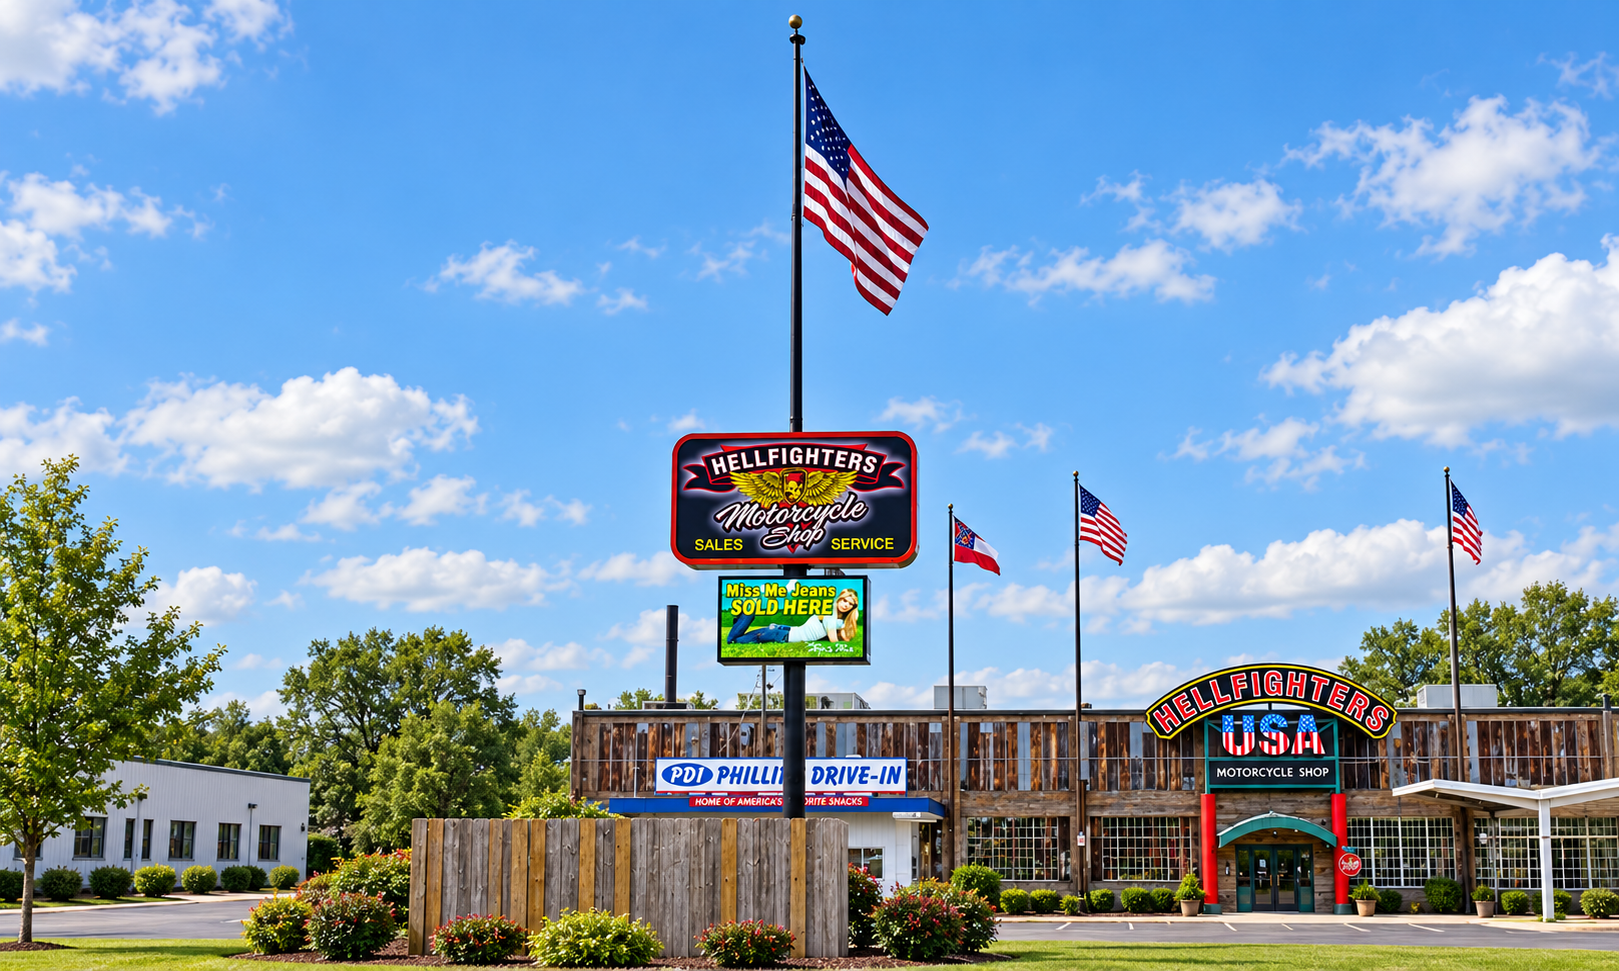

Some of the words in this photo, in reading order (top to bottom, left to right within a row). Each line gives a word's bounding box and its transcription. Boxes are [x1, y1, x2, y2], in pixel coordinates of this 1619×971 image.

[711, 447, 878, 475] HELLFIGHTERS
[715, 493, 868, 531] Motorcycle
[694, 538, 743, 551] SALES
[762, 524, 824, 548] Shop
[831, 537, 894, 550] SERVICE
[726, 583, 760, 598] Miss
[765, 583, 787, 597] Me
[791, 582, 836, 597] Jeans
[731, 599, 778, 616] SOLD
[783, 599, 833, 615] HERE
[1153, 670, 1390, 734] HELLFIGHTERS
[1221, 713, 1326, 756] USA
[670, 766, 705, 784] PDI
[716, 765, 784, 785] PHILLI
[810, 765, 902, 786] DRIVE-IN
[1216, 767, 1293, 778] MOTORCYCLE
[1299, 767, 1329, 778] SHOP
[695, 797, 721, 806] HOME
[723, 797, 736, 806] OF
[737, 797, 783, 806] AMERICA'S
[828, 797, 863, 806] SNACKS
